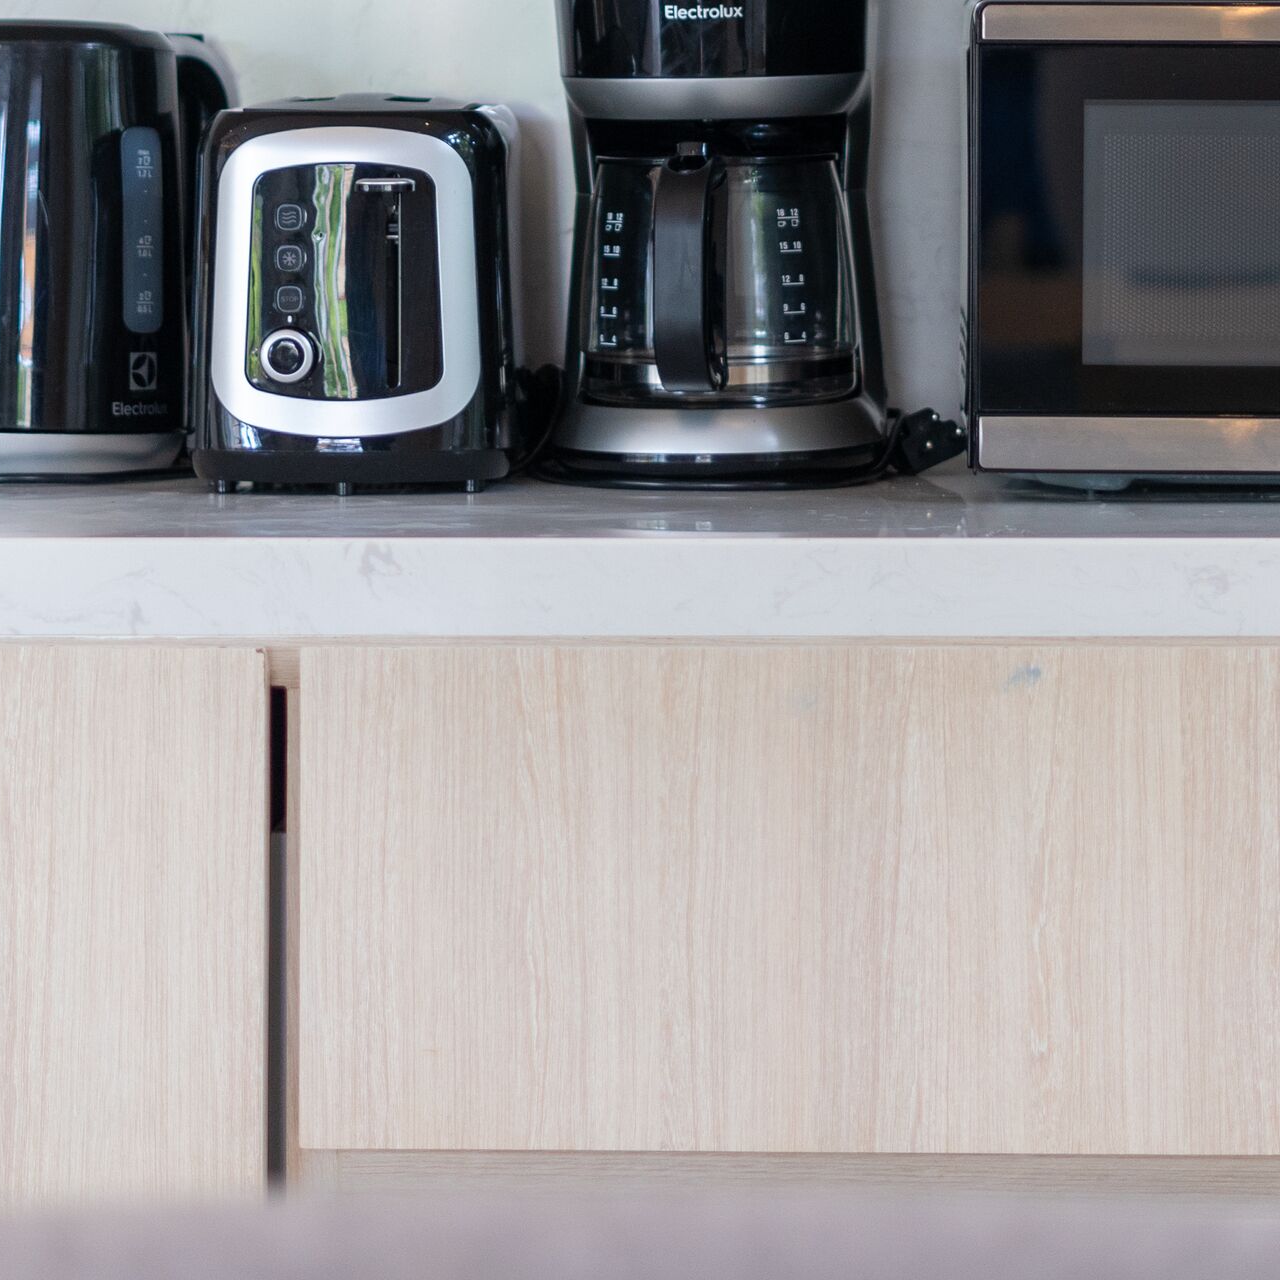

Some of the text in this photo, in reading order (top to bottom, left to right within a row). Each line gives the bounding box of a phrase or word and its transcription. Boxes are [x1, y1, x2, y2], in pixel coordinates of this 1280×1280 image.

[663, 4, 744, 20] Electrolux
[790, 208, 798, 216] 12
[779, 241, 802, 249] 15 10
[280, 295, 298, 303] STOP
